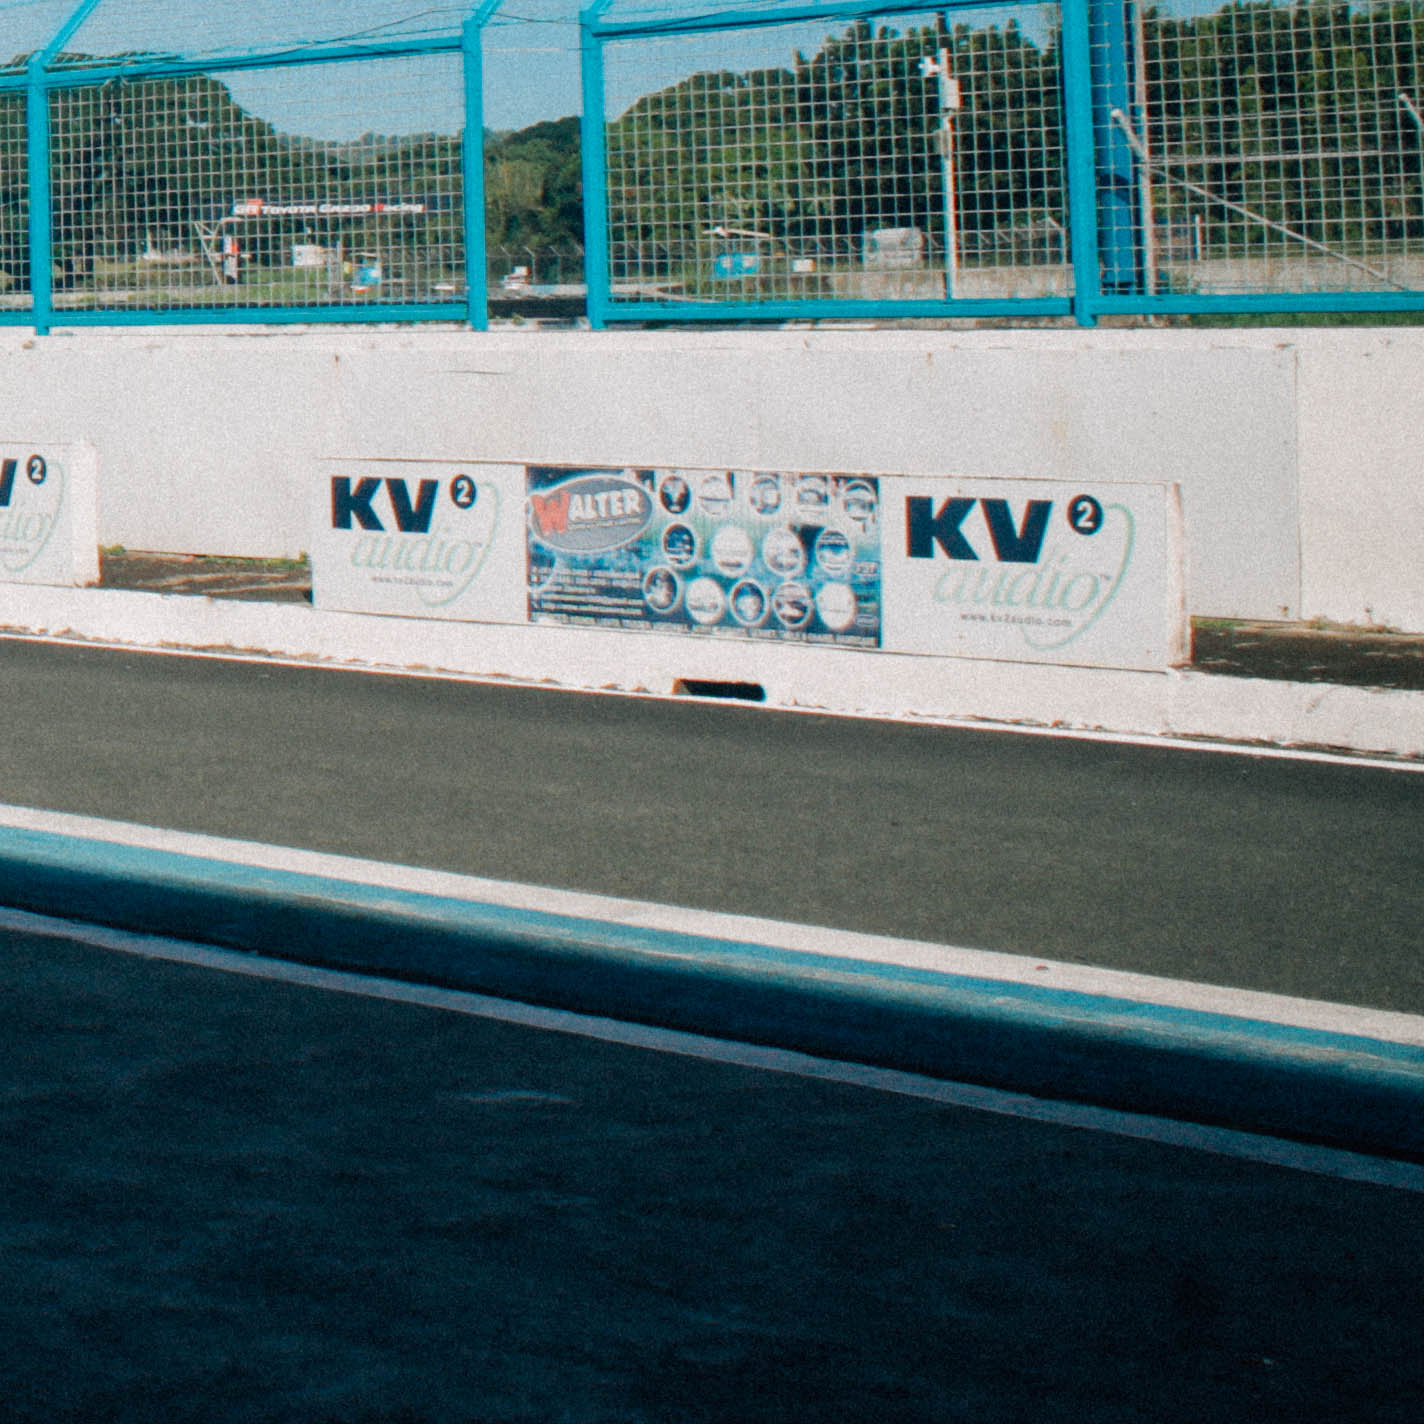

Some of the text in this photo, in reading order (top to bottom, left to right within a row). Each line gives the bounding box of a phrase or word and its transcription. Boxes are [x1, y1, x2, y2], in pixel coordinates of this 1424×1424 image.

[531, 488, 646, 536] WALTER
[352, 528, 475, 574] audio
[934, 556, 1100, 611] audio
[959, 612, 1072, 626] www.kv2audio.com
